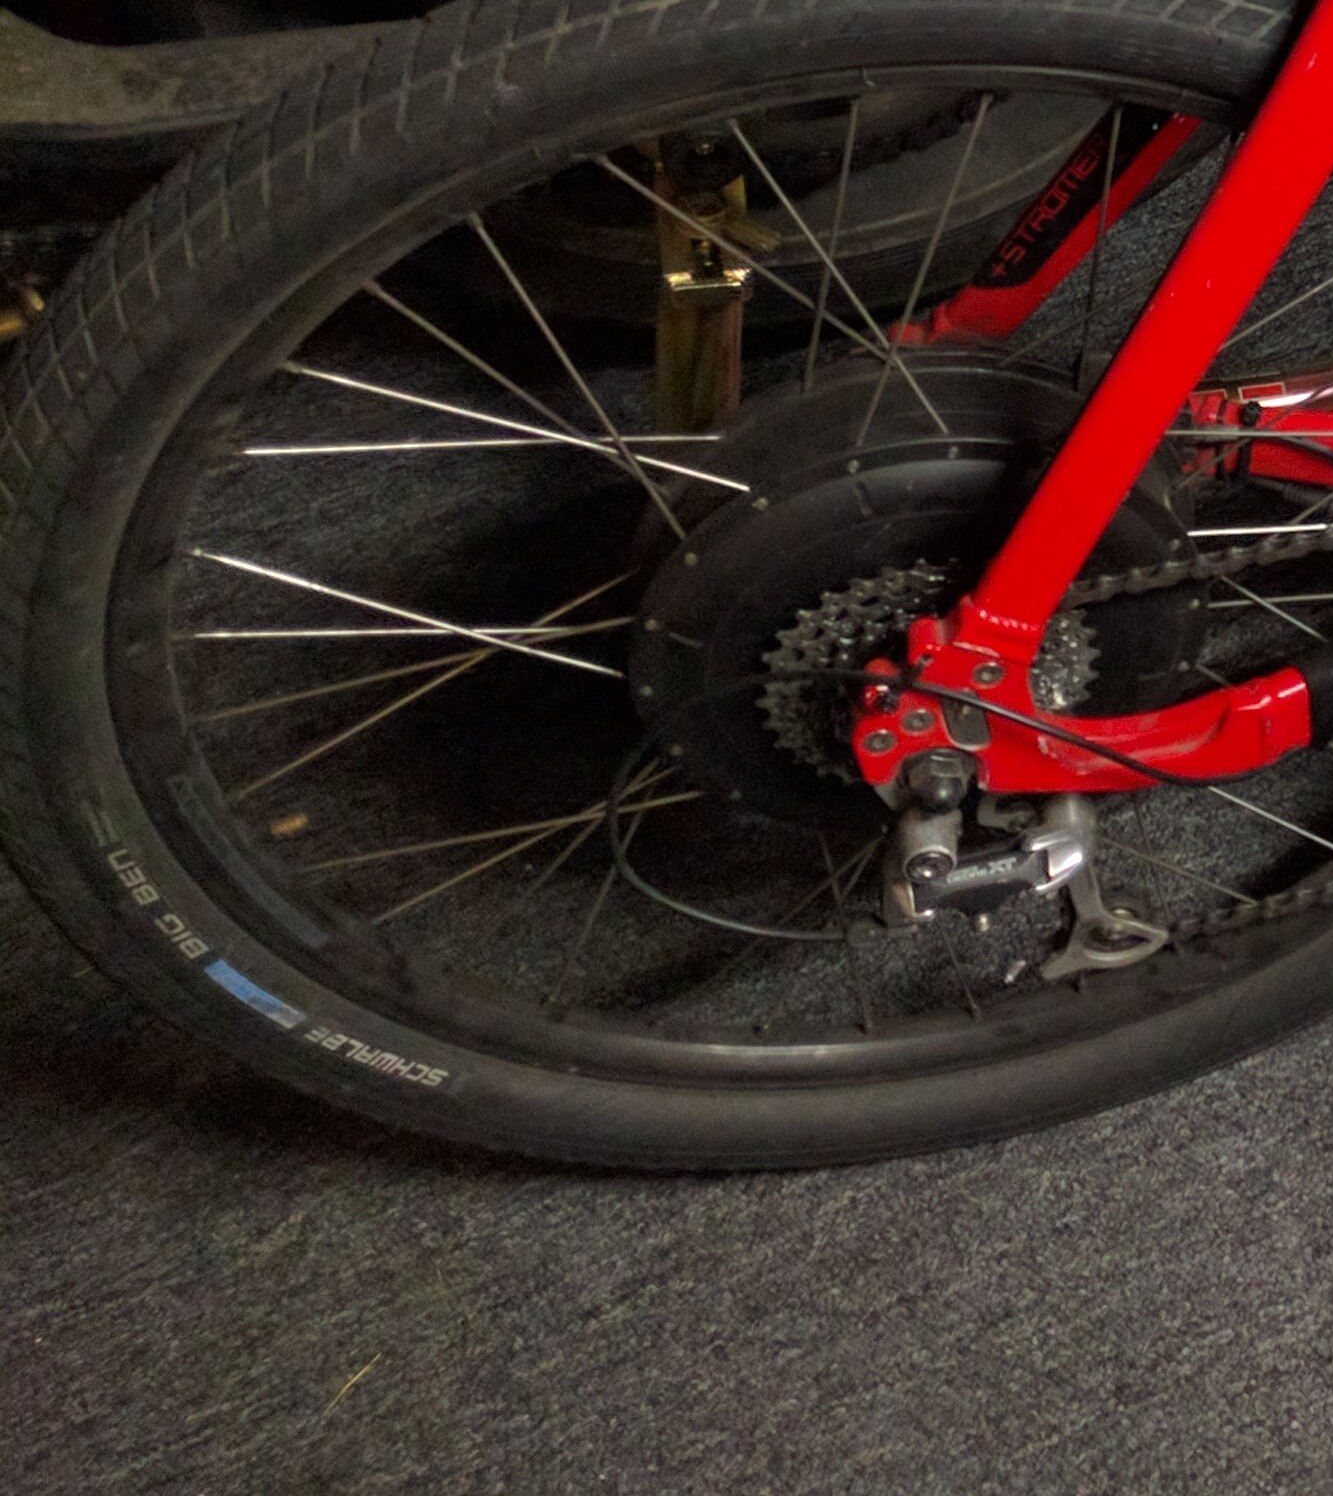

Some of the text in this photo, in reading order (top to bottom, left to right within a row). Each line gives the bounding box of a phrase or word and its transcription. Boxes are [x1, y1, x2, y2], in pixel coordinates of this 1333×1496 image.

[105, 848, 211, 961] BIG BEN
[302, 1024, 450, 1087] SCHWALBE
